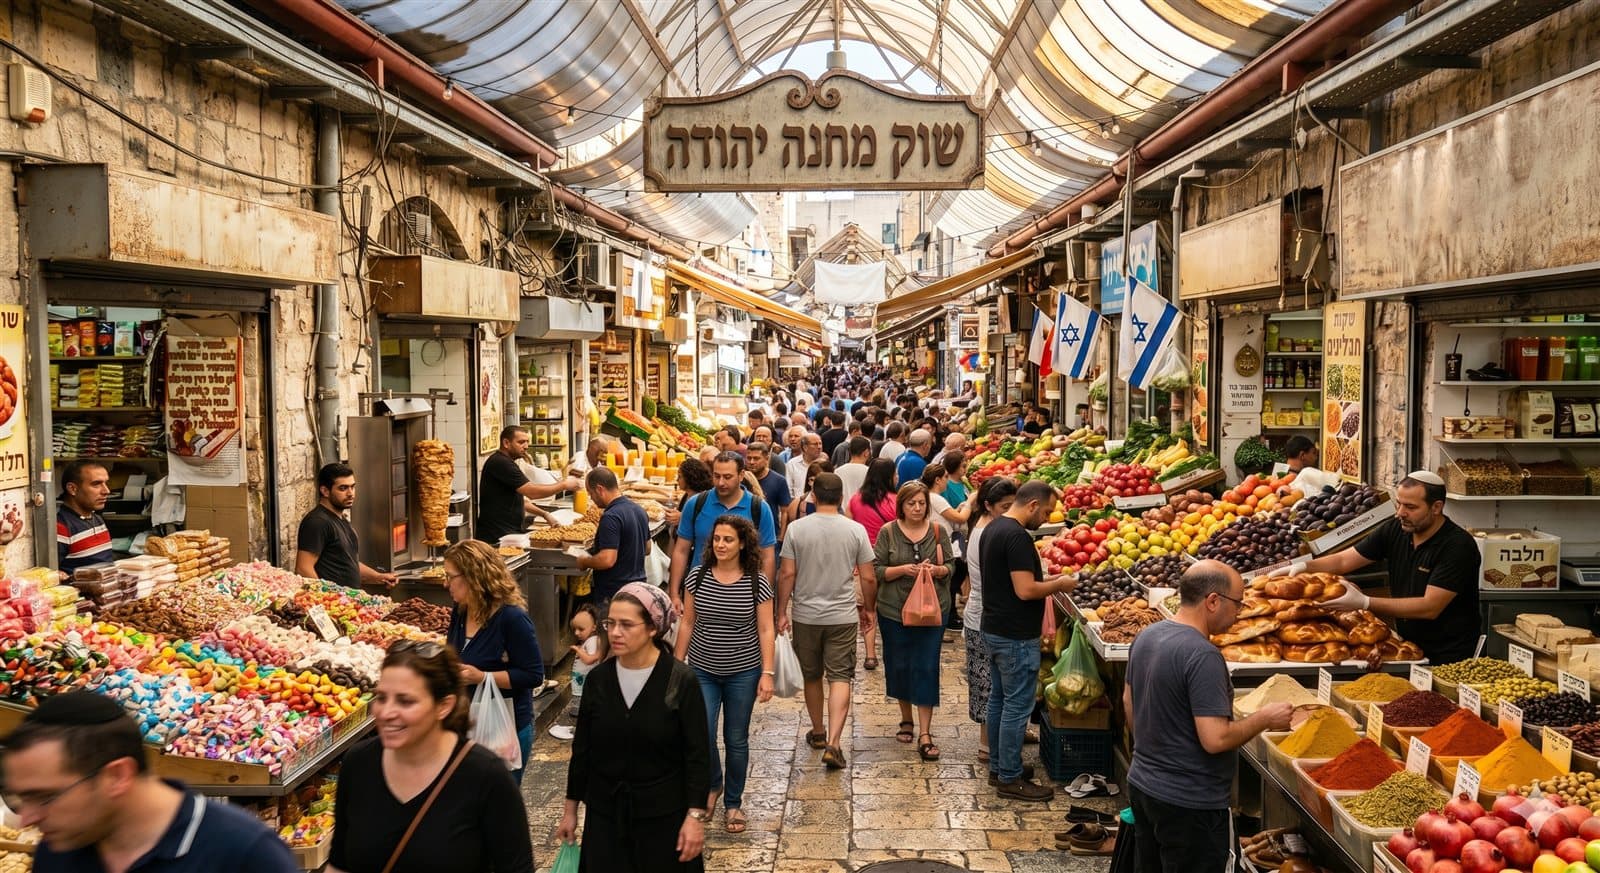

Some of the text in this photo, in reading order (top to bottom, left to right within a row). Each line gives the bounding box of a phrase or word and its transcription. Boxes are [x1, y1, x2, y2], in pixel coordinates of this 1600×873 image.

[666, 122, 965, 180] שוק מחנה יהודה
[1333, 311, 1356, 331] שקות
[1500, 545, 1545, 561] חלבה
